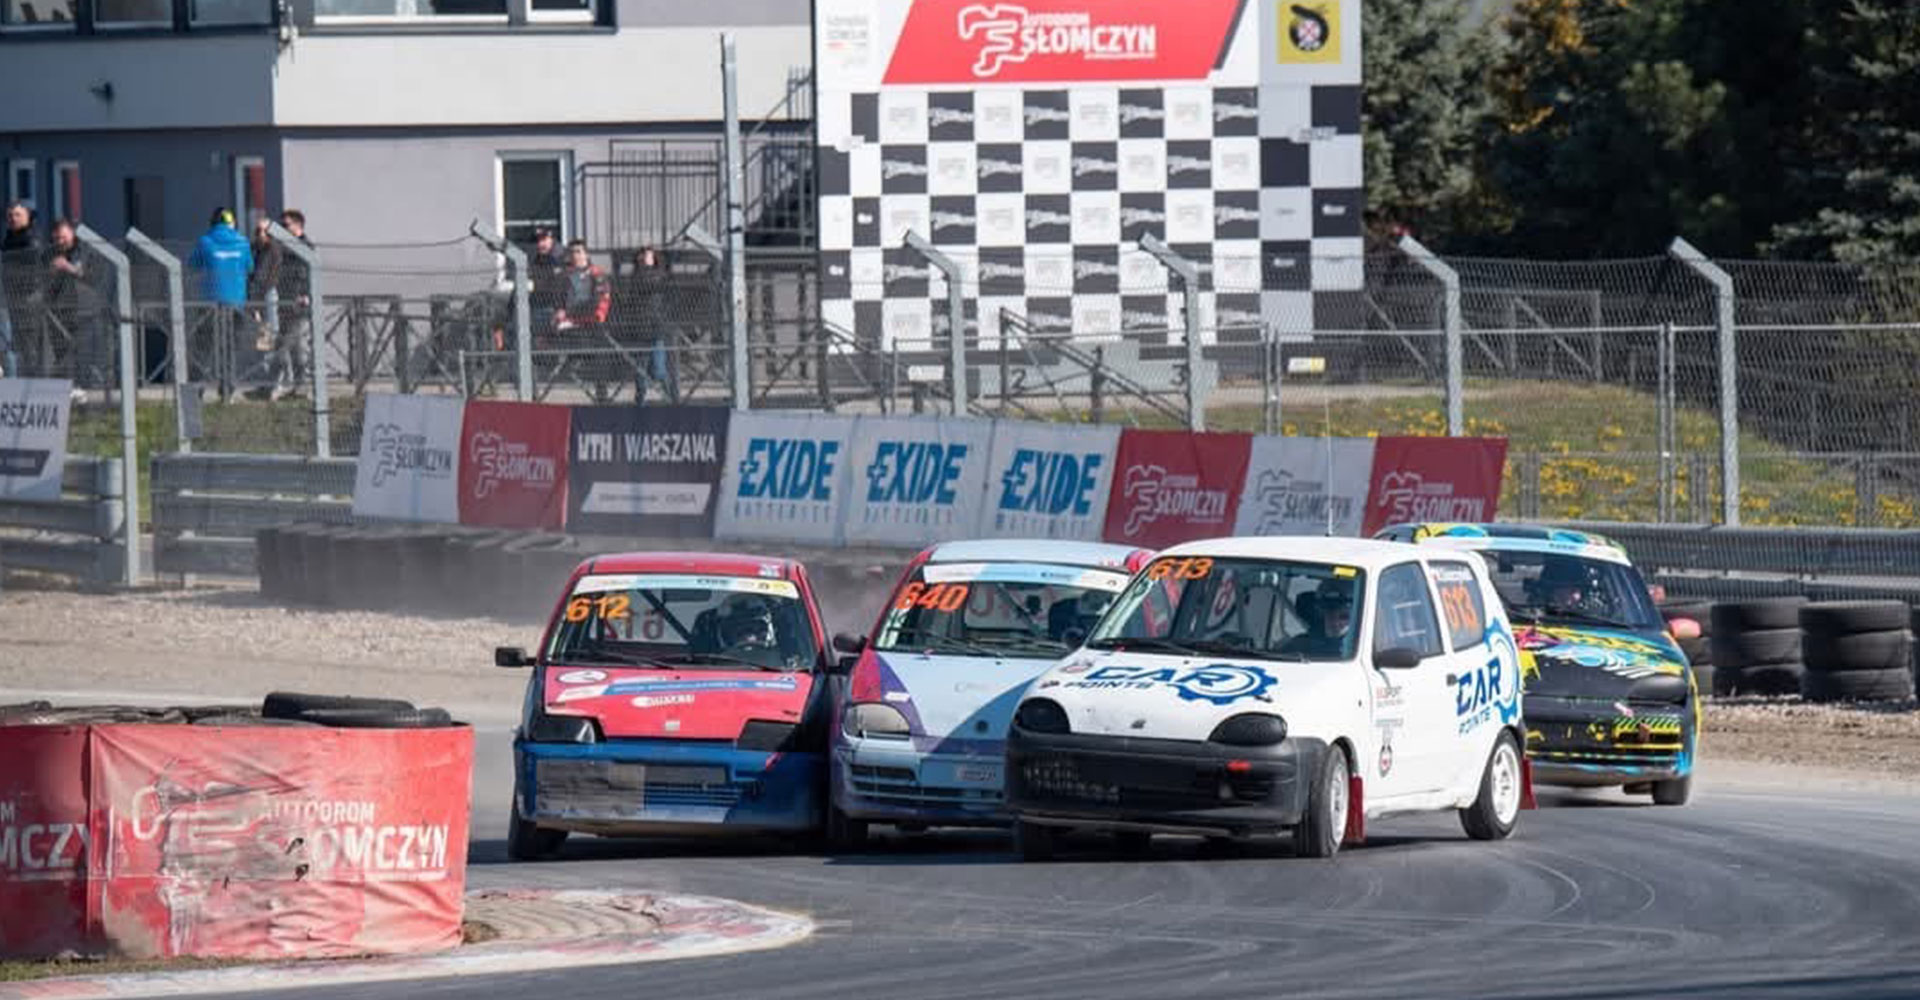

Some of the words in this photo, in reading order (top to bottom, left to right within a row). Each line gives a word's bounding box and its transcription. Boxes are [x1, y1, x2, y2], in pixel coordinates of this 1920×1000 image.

[1021, 26, 1156, 53] SŁOMCZYN
[624, 433, 717, 463] WARSZAWA
[738, 438, 839, 500] EXIDE
[867, 441, 968, 504] EXIDE
[1000, 448, 1102, 516] EXIDE
[1148, 557, 1214, 581] 613
[566, 592, 630, 623] 612
[896, 581, 969, 613] 640
[1085, 666, 1236, 687] CAR
[1456, 656, 1501, 717] CAR
